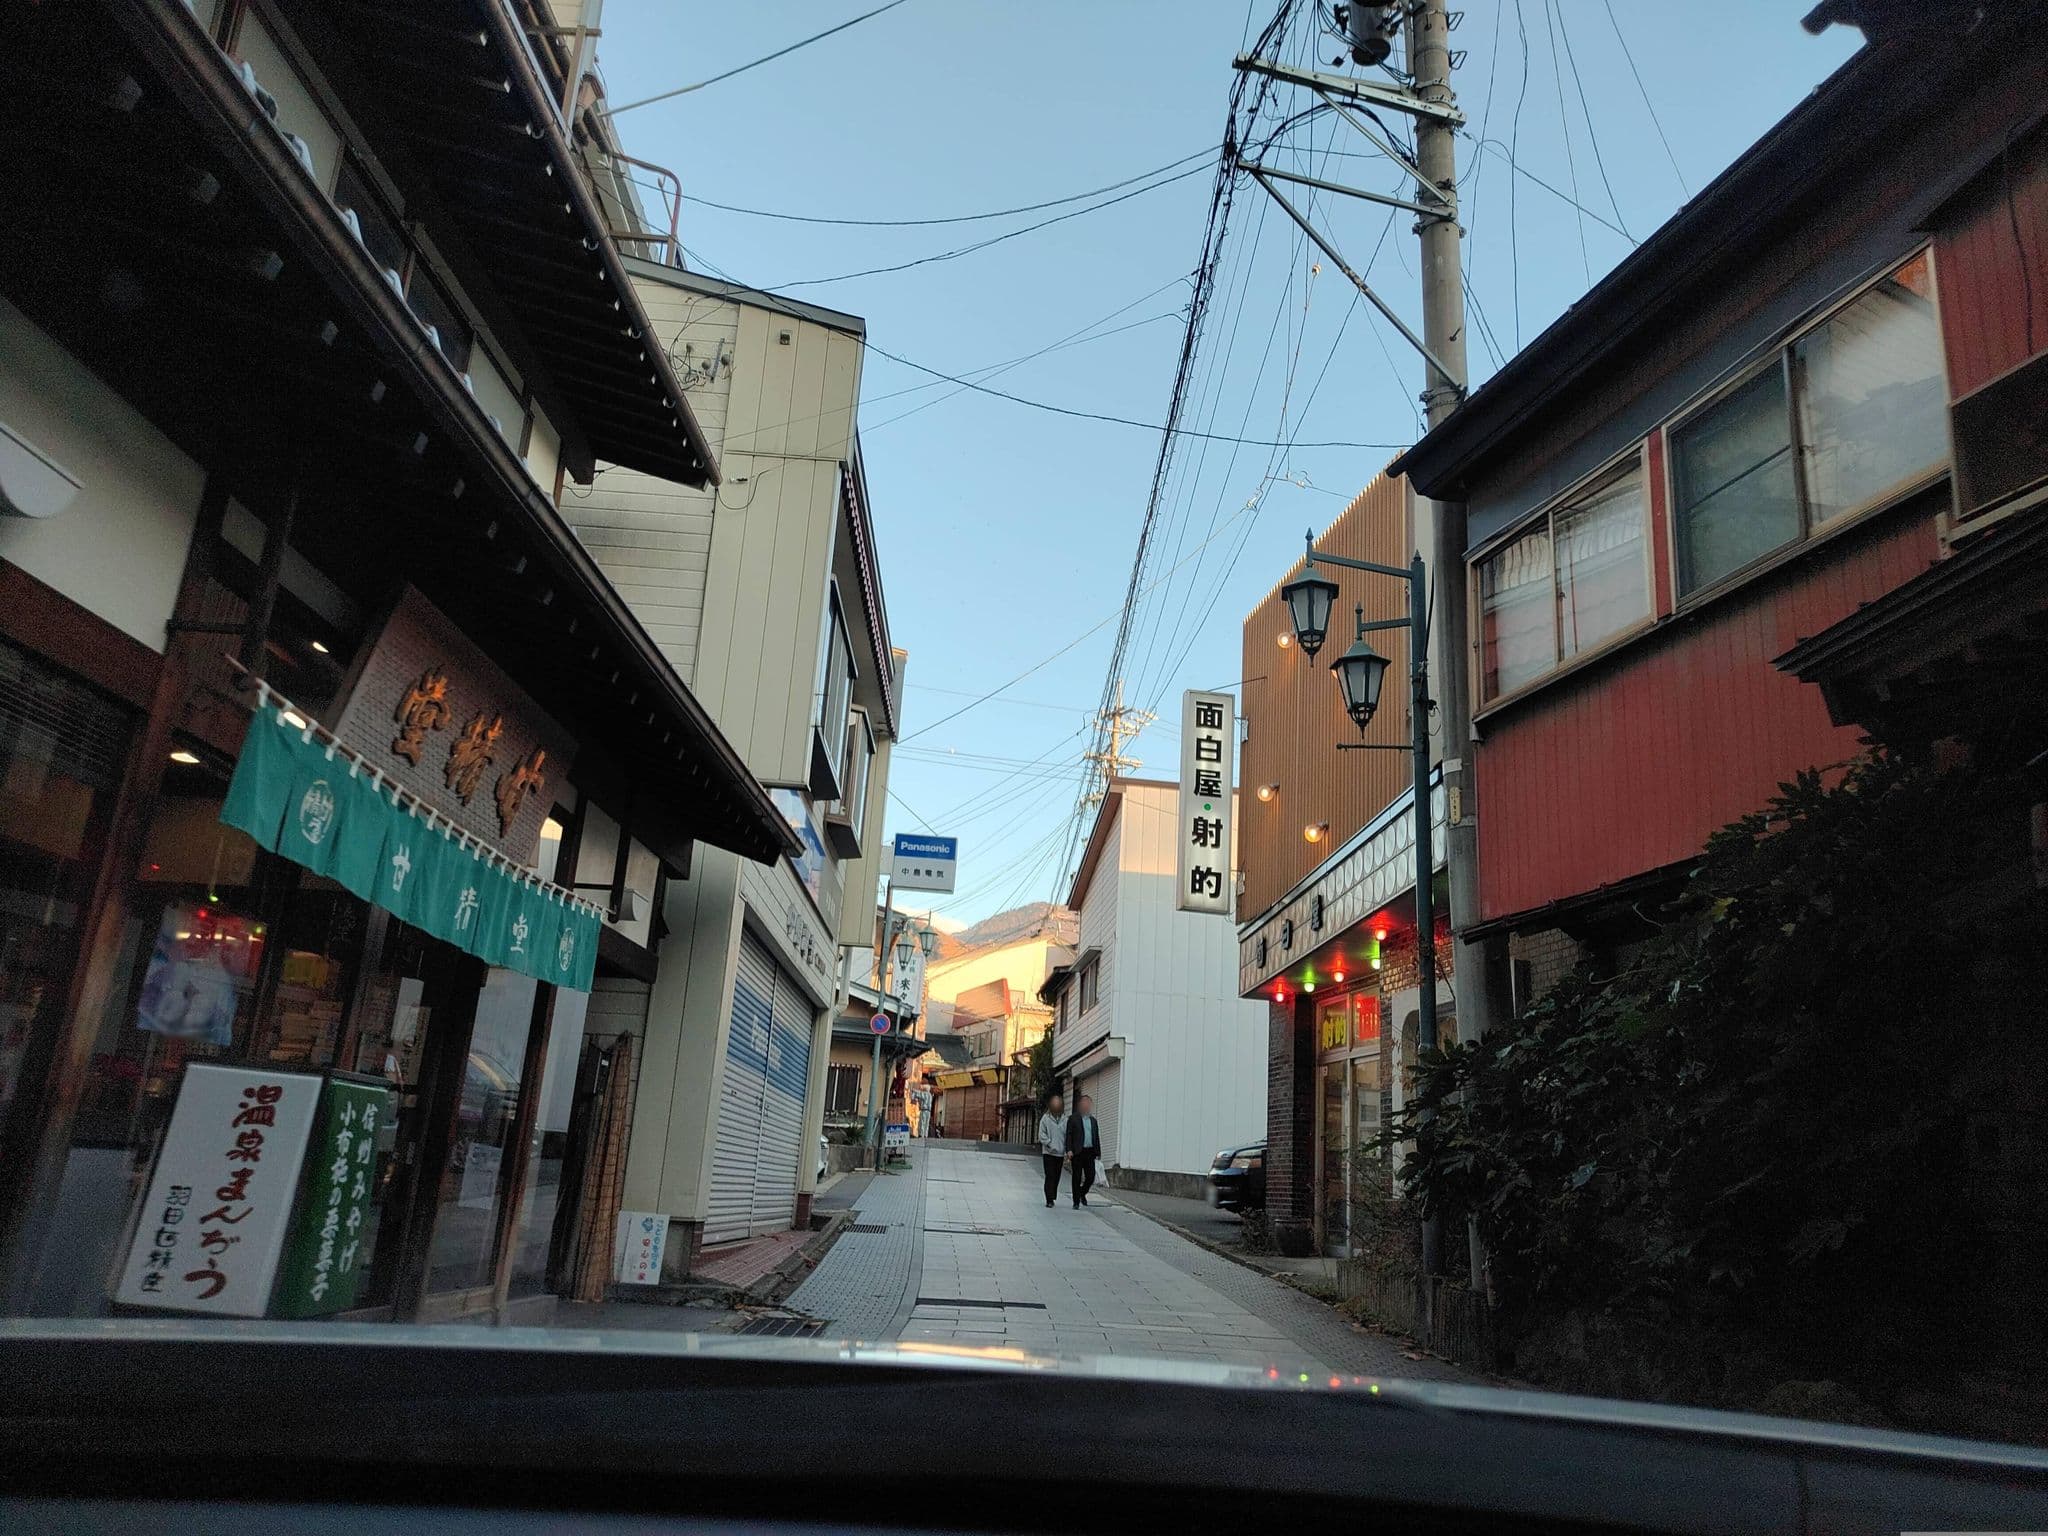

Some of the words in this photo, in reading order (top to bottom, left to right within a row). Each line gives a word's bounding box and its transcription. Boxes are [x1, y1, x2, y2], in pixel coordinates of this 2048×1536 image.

[900, 841, 950, 854] Panasonic
[1190, 700, 1224, 899] 面白屋・射的
[183, 1084, 283, 1300] 温泉まんぢう
[338, 1102, 379, 1274] 信州みやげ
